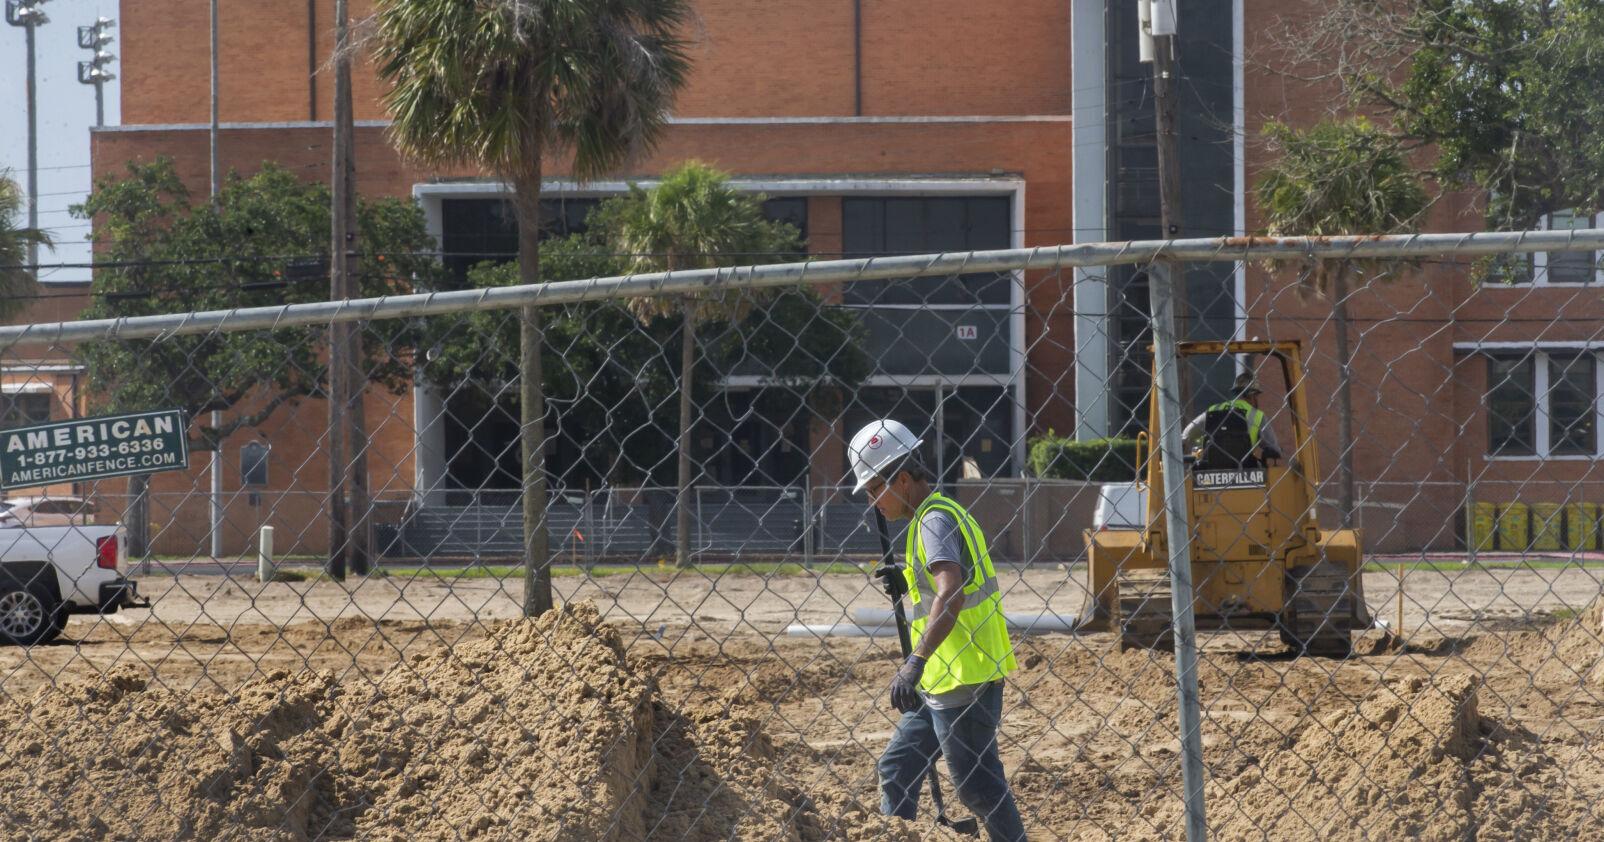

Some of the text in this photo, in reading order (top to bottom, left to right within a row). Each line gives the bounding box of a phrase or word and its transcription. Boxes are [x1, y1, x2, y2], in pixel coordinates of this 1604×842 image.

[960, 327, 975, 337] 1A
[7, 416, 173, 453] AMERICAN
[17, 438, 164, 467] 1-877-933-6336
[11, 452, 176, 483] AMERICANFENCE.COM
[1197, 471, 1264, 485] CATERPILLAR
